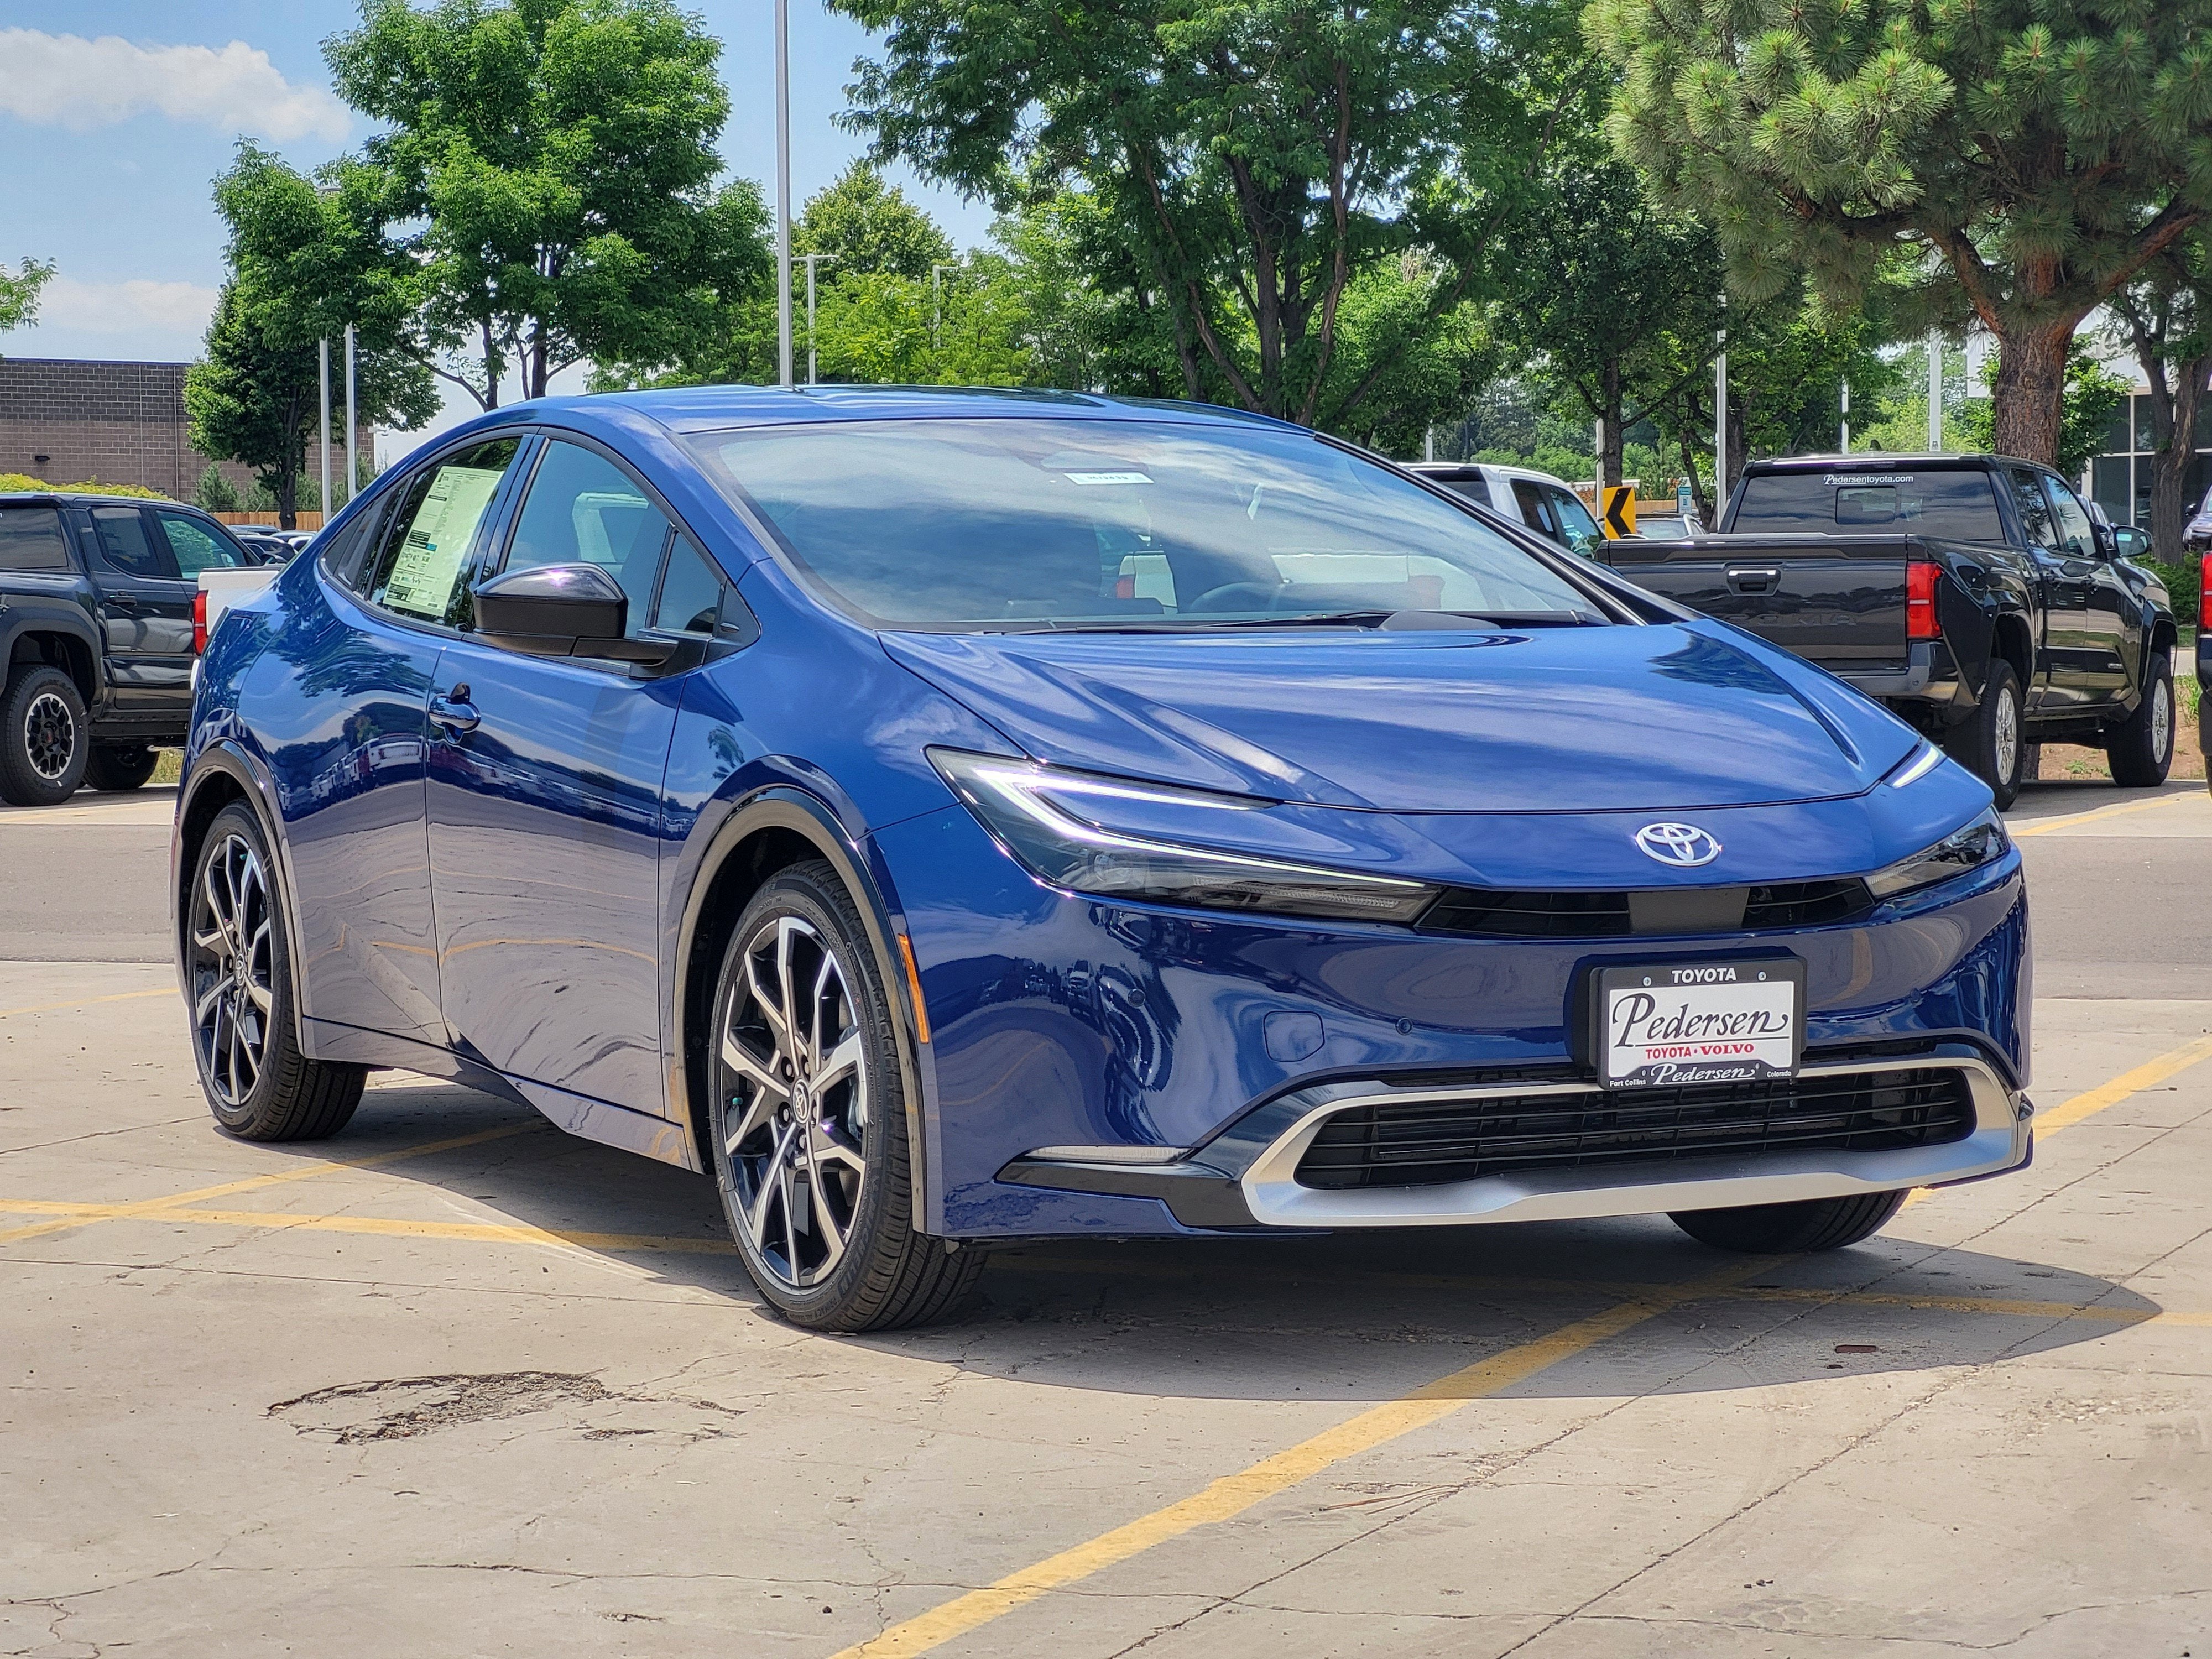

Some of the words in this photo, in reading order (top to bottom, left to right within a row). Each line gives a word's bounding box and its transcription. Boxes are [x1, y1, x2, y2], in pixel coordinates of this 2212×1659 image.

[1823, 474, 1914, 485] Pedersentoyota.com
[1672, 968, 1736, 984] TOYOTA
[1612, 993, 1788, 1048] Pedersen
[1646, 1049, 1692, 1060] TOYOTA
[1700, 1044, 1754, 1055] VOLVO
[1650, 1063, 1756, 1085] Pedersen
